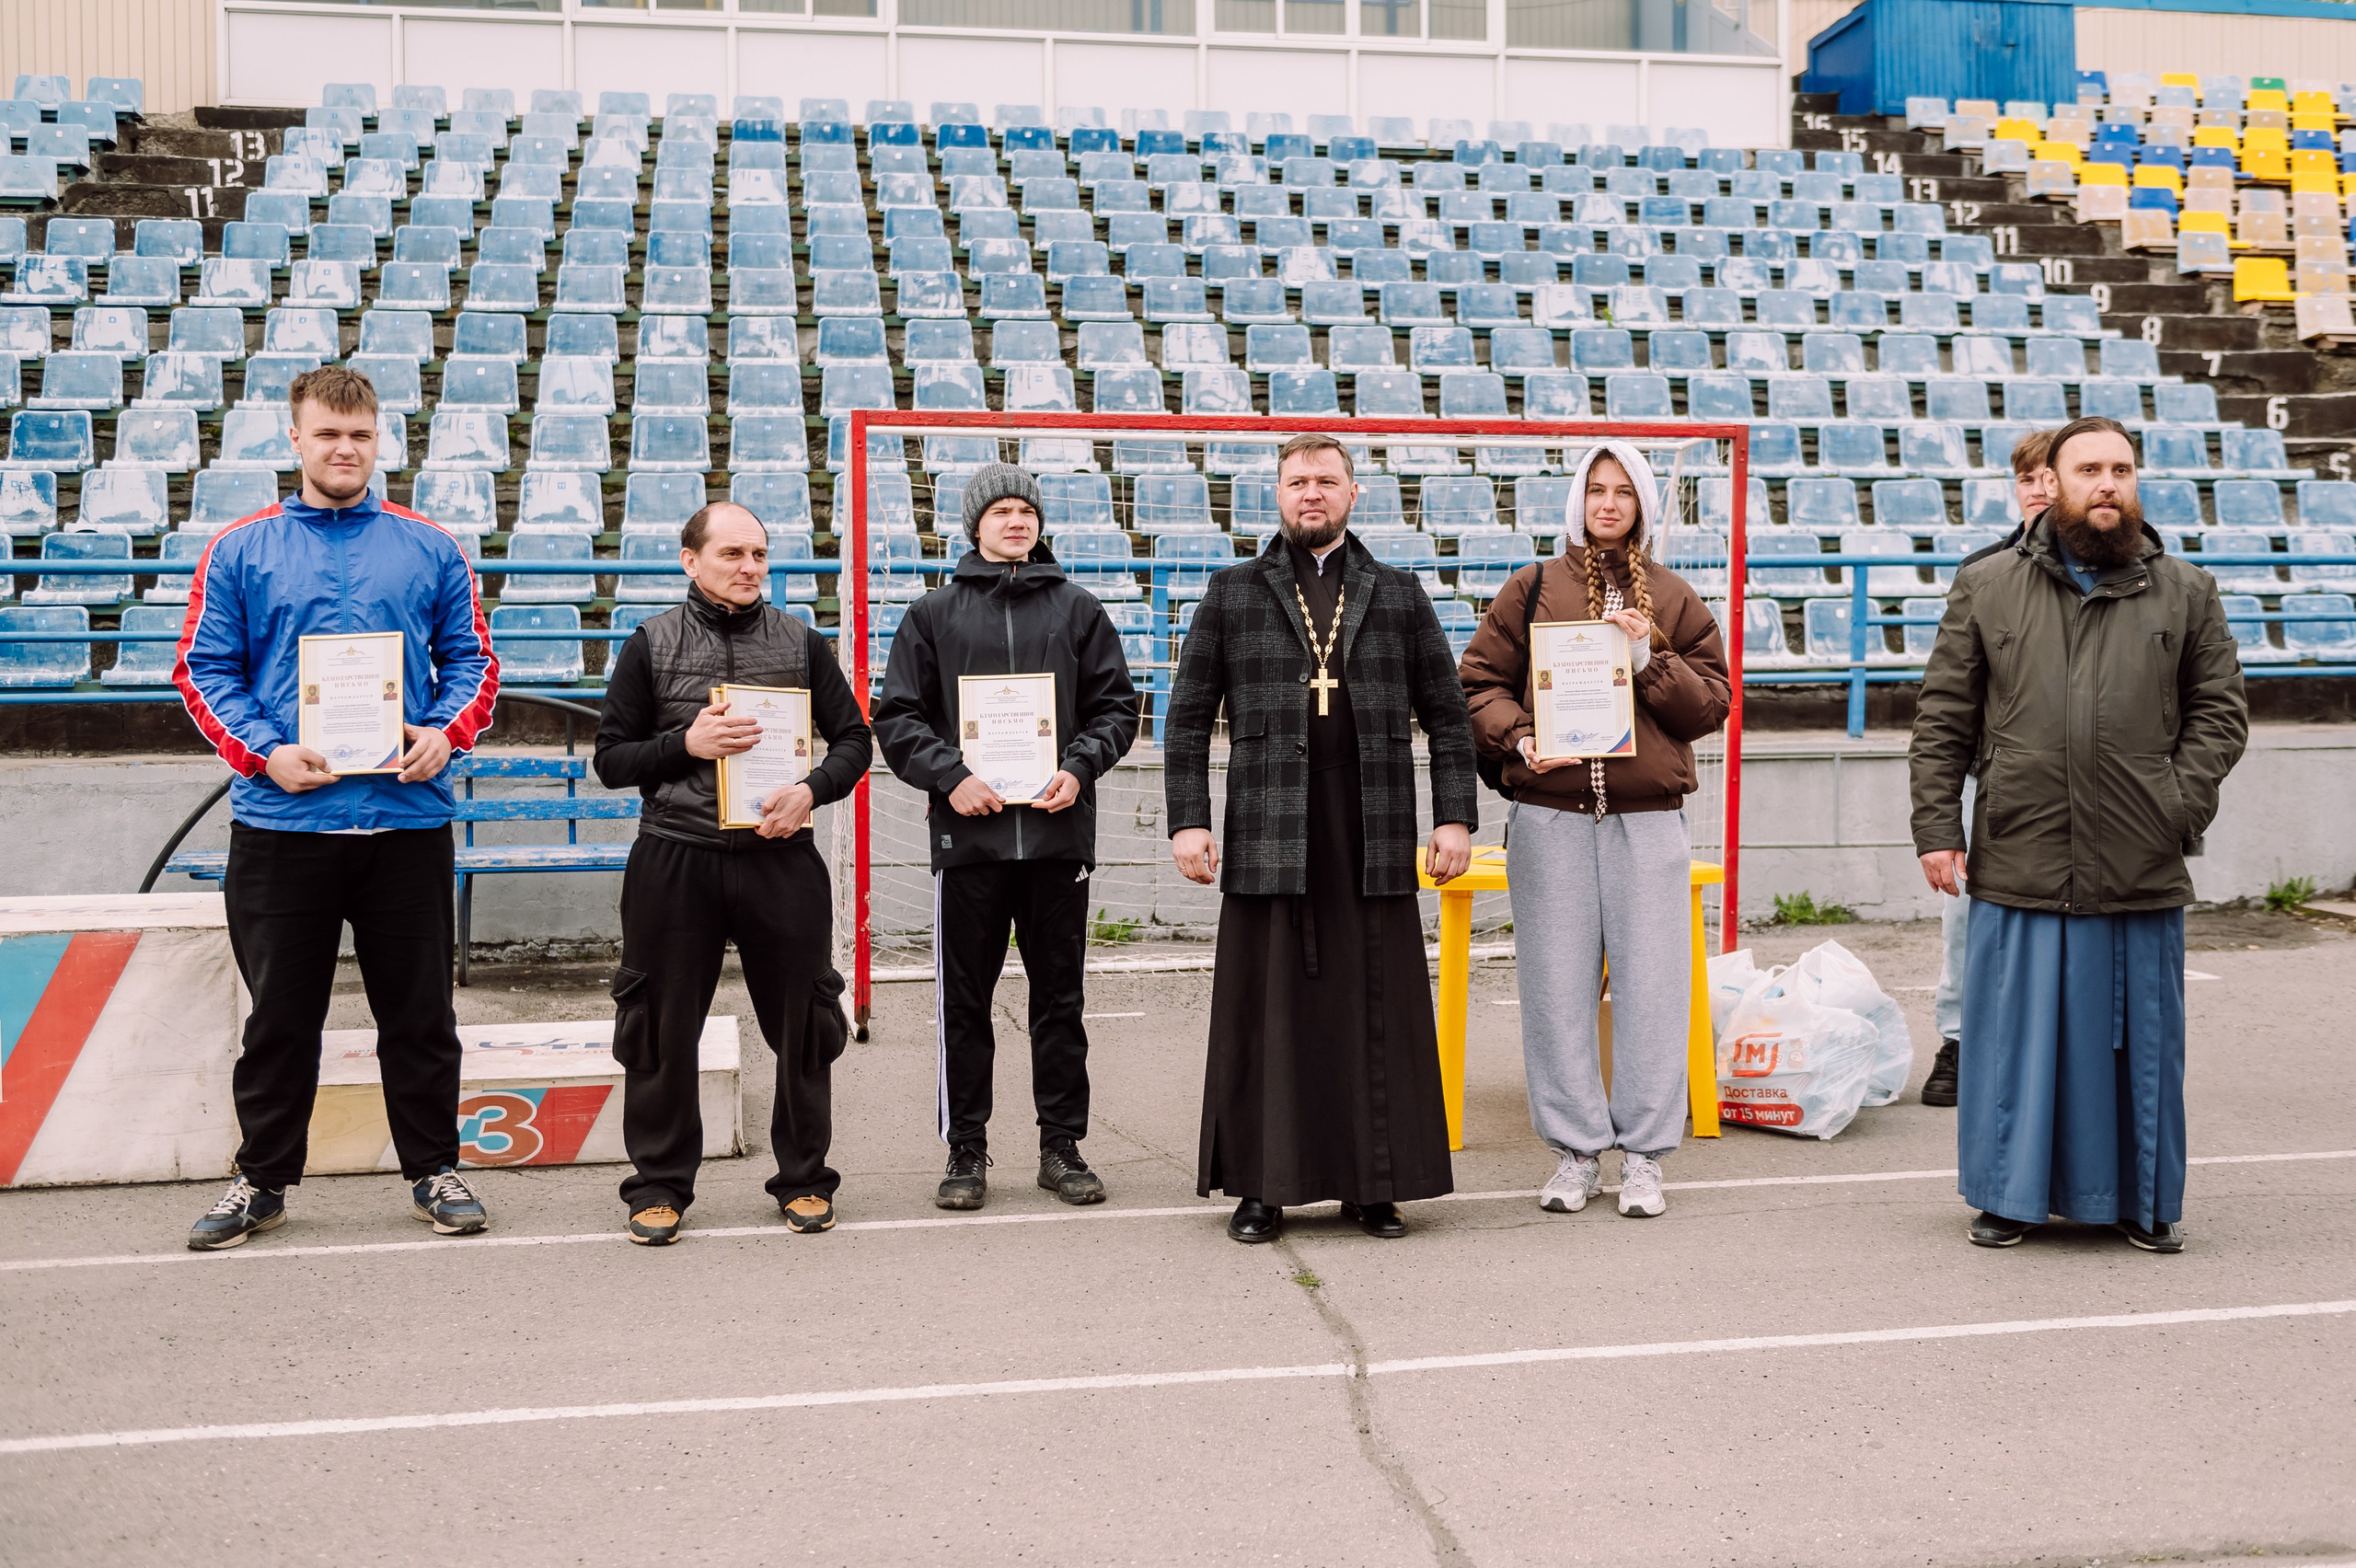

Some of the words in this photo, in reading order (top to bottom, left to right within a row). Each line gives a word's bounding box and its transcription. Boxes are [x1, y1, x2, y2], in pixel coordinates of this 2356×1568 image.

[230, 132, 265, 160] 13
[1838, 129, 1867, 153] 15
[207, 158, 245, 187] 12
[1873, 152, 1903, 175] 14
[184, 186, 216, 218] 11
[1909, 178, 1939, 202] 13
[1950, 201, 1981, 225] 12
[1992, 226, 2018, 255] 11
[2039, 259, 2073, 284] 10
[2090, 282, 2111, 313] 9
[2141, 316, 2163, 346] 8
[2201, 352, 2224, 377] 7
[2267, 397, 2290, 430] 6
[1724, 1086, 1788, 1099] Доставка
[1723, 1109, 1737, 1119] от
[1739, 1107, 1753, 1120] 15
[1755, 1111, 1796, 1124] минут
[459, 1091, 544, 1167] 3
